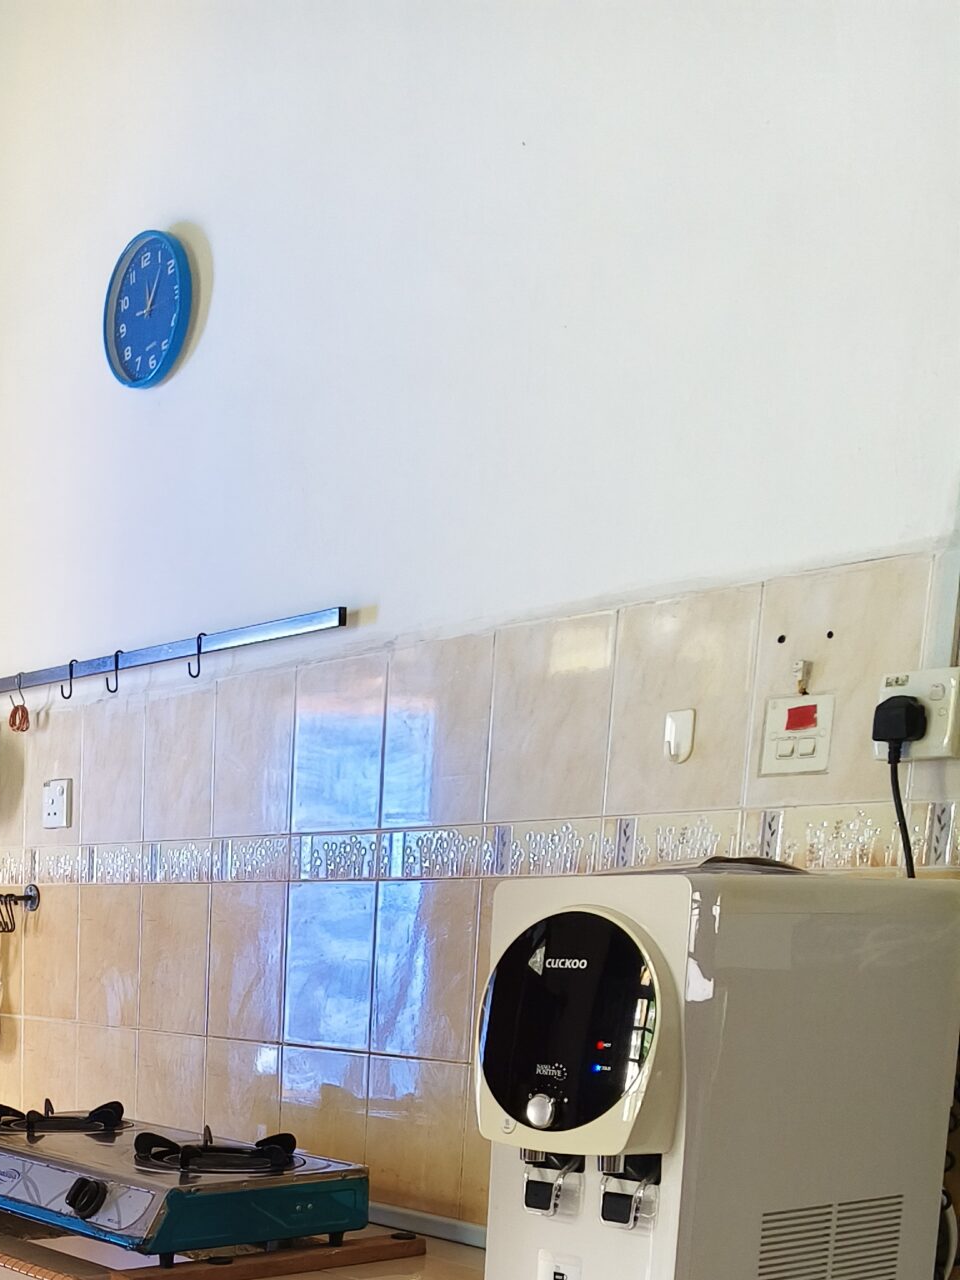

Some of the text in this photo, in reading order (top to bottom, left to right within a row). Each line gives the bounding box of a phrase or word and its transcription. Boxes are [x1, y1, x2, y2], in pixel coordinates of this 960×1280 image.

[141, 251, 151, 268] 12
[167, 258, 175, 274] 2
[129, 270, 136, 285] 11
[119, 296, 130, 313] 10
[119, 324, 127, 339] 9
[124, 346, 132, 361] 8
[135, 355, 142, 372] 7
[148, 354, 157, 369] 6
[545, 958, 588, 969] CUCKOO
